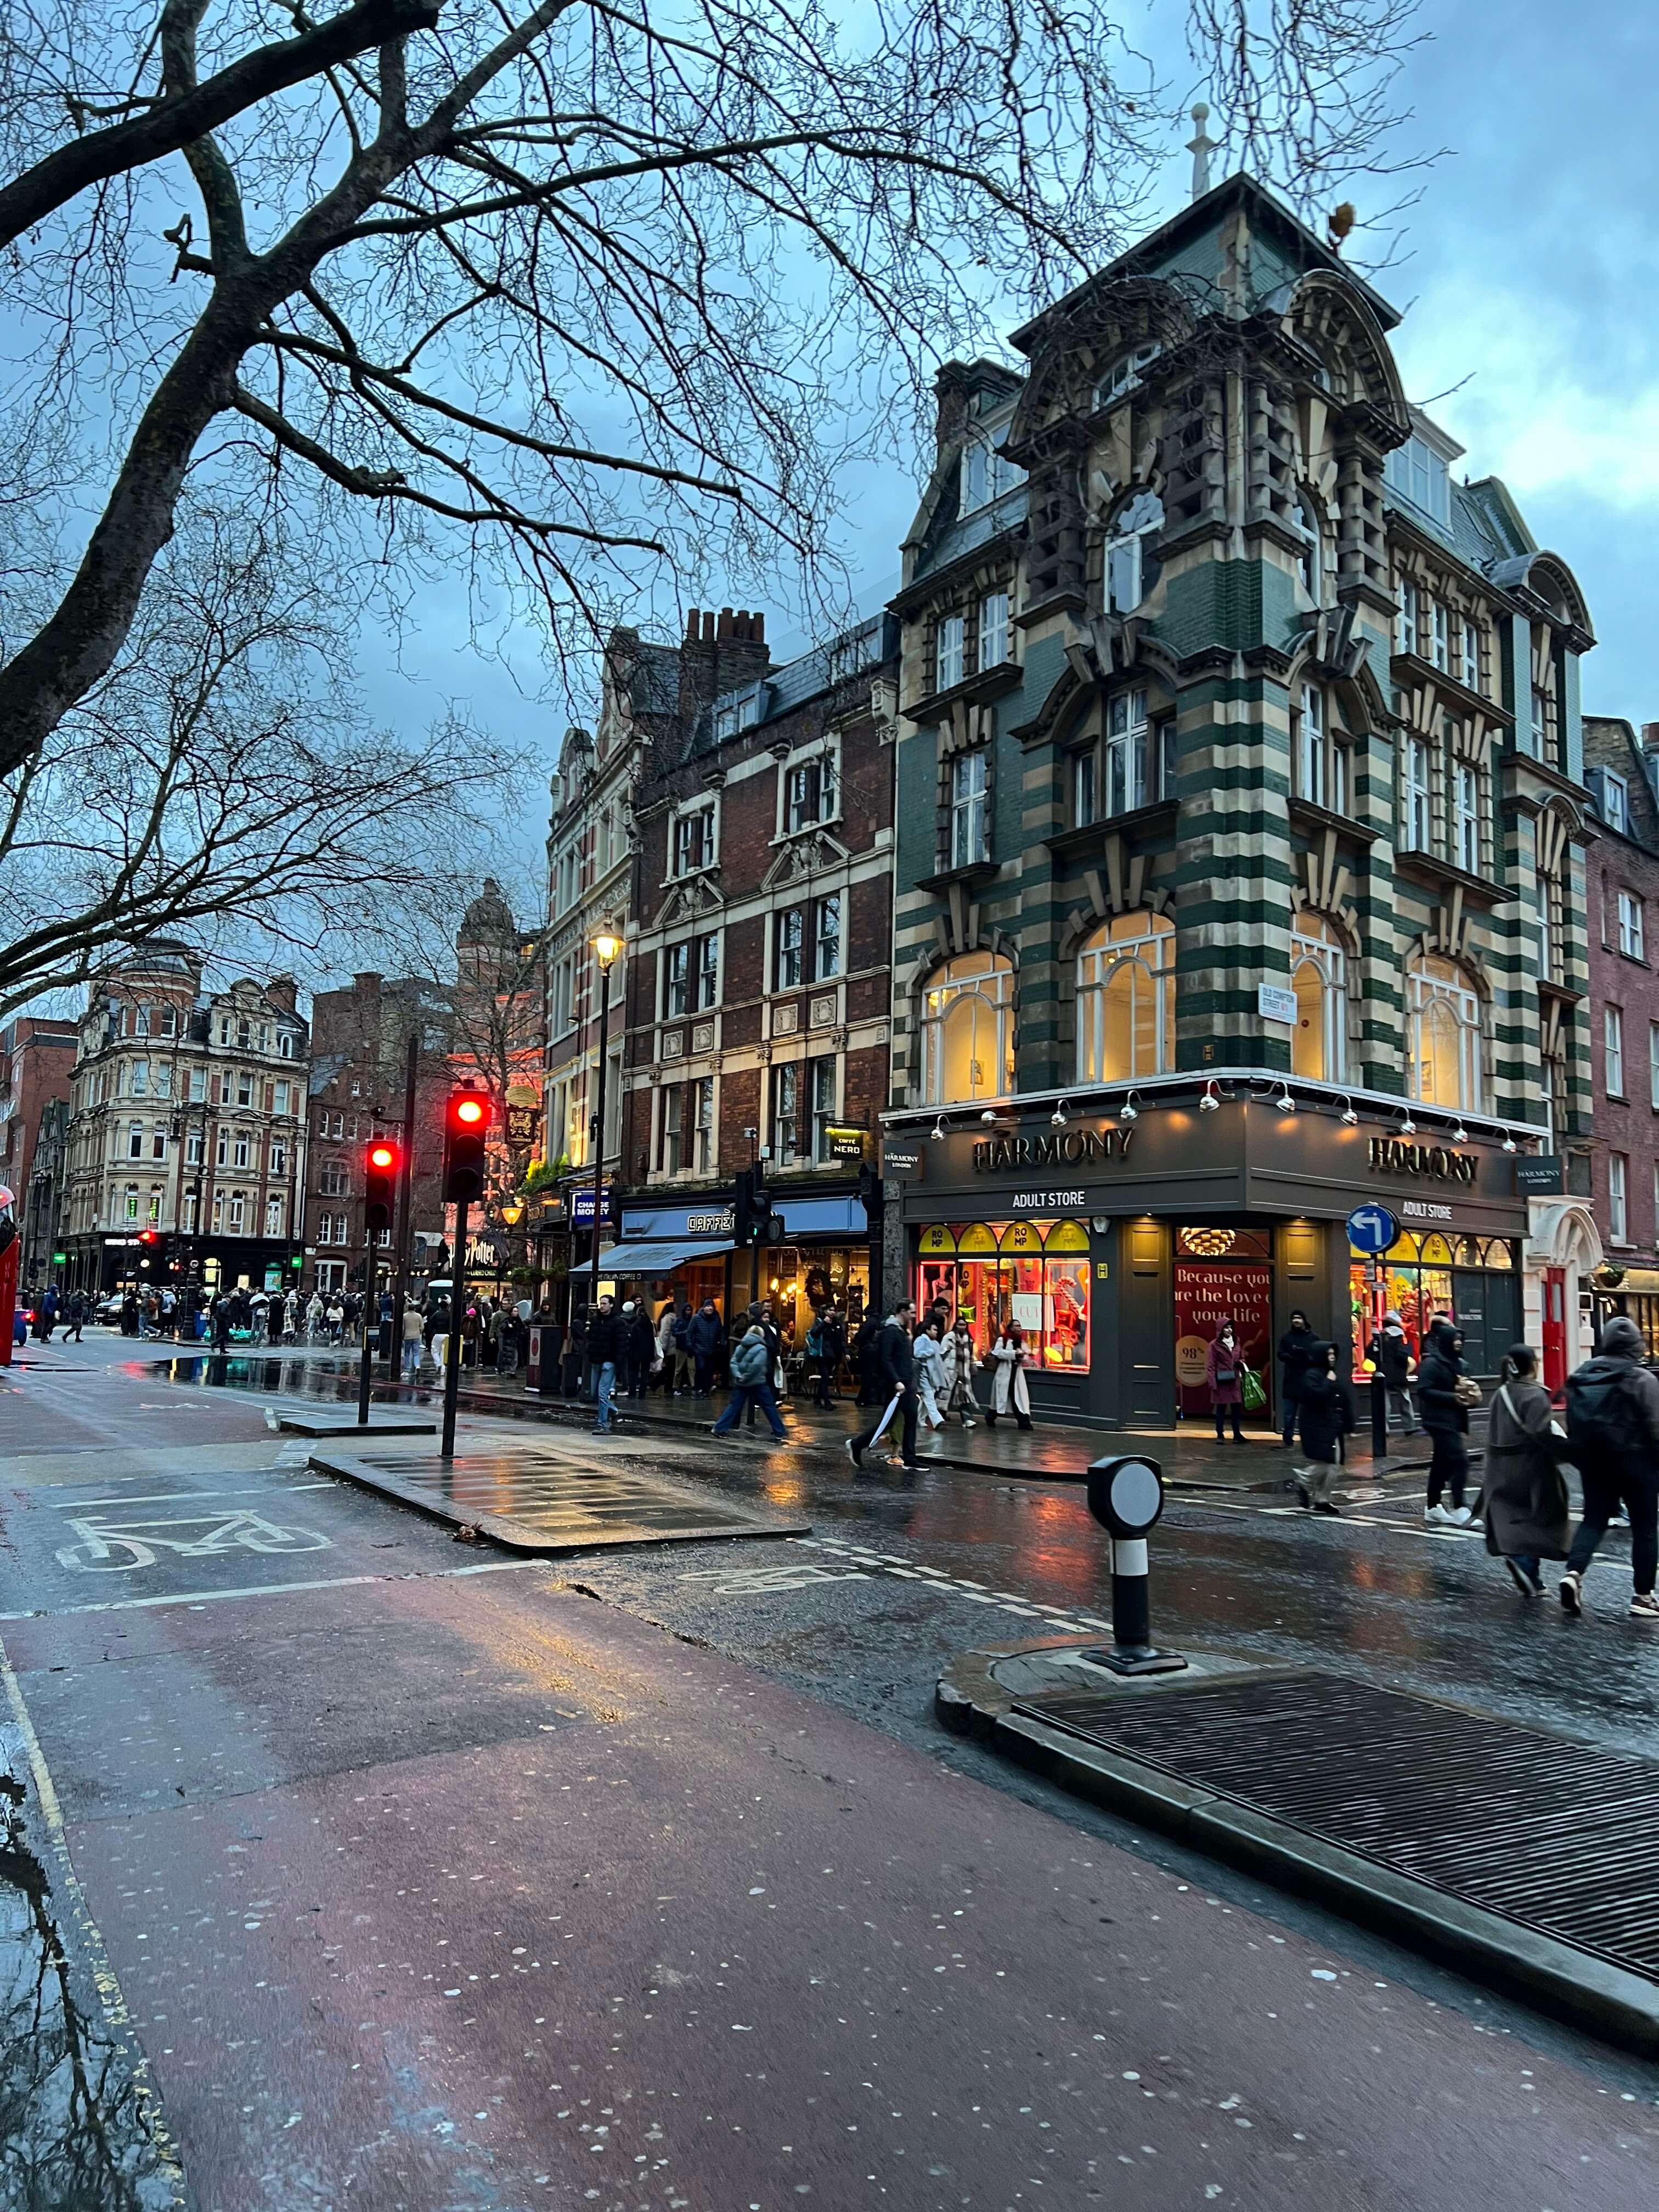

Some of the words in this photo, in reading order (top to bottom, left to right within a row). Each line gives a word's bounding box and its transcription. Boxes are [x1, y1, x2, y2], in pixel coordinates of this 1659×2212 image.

[834, 1146, 860, 1154] NERO
[1013, 1193, 1045, 1207] ADULT
[1048, 1191, 1085, 1205] STORE
[1403, 1201, 1427, 1217] ADULT
[932, 1230, 943, 1238] RO
[1015, 1228, 1027, 1236] RO
[932, 1239, 943, 1248] MP
[1014, 1238, 1027, 1246] MP
[471, 1236, 495, 1268] Potter
[1177, 1268, 1243, 1284] Because
[1195, 1288, 1222, 1302] the
[1226, 1289, 1262, 1304] love
[1234, 1308, 1260, 1323] life
